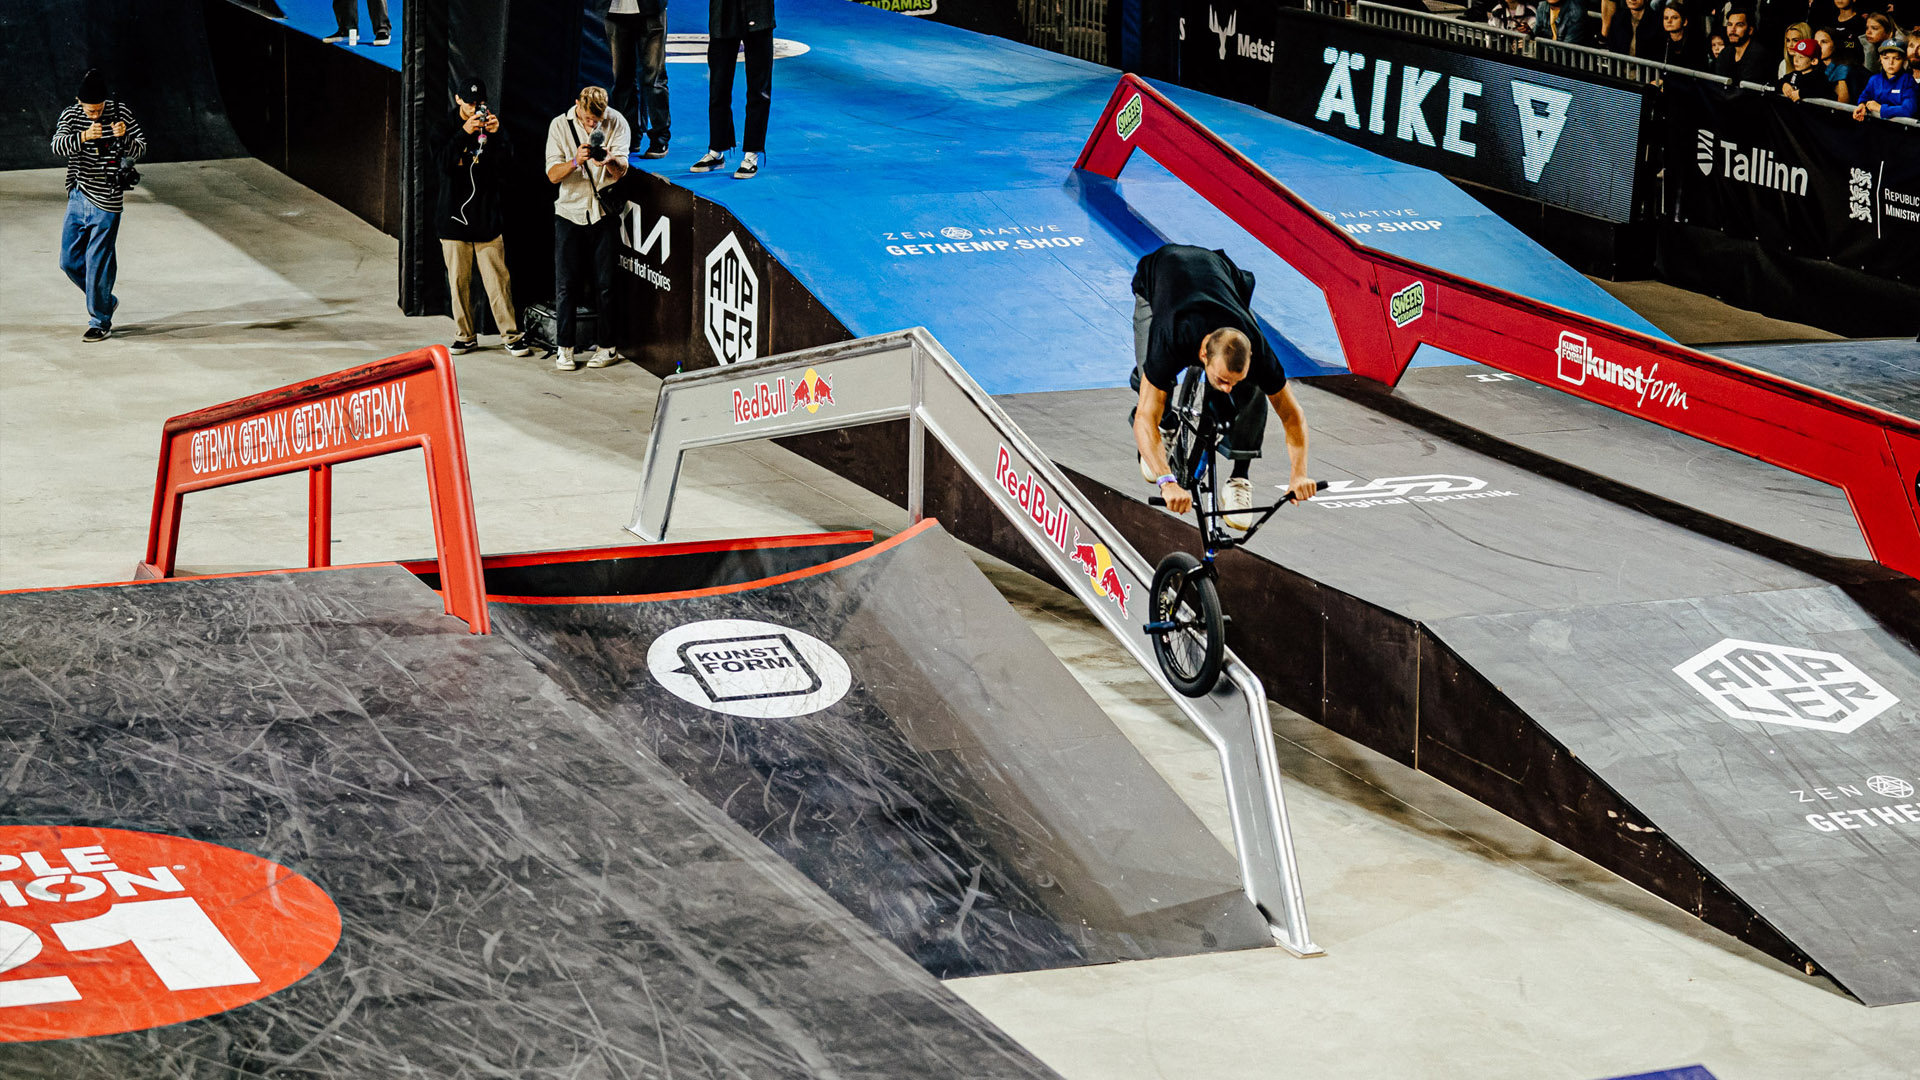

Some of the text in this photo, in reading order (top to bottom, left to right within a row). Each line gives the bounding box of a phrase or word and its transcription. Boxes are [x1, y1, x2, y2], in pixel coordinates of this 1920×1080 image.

[859, 0, 931, 11] NDAMAS
[1314, 46, 1483, 158] ÄIKE
[1720, 139, 1808, 196] Tallinn
[1340, 208, 1419, 219] NATIVE
[882, 224, 1063, 241] ZEN NATIVE
[886, 236, 1086, 256] GETHEMP.SHOP
[634, 258, 647, 279] that
[647, 264, 671, 292] inspires
[1392, 285, 1423, 318] SWEETS
[1561, 340, 1584, 355] KUNST
[1561, 348, 1583, 365] FORM
[1586, 346, 1689, 410] kunstform
[1317, 488, 1520, 509] Digital Sputnik
[694, 646, 780, 663] KUNST
[702, 656, 794, 675] FORM
[1790, 784, 1863, 802] ZEN
[1806, 802, 1920, 832] GETHE
